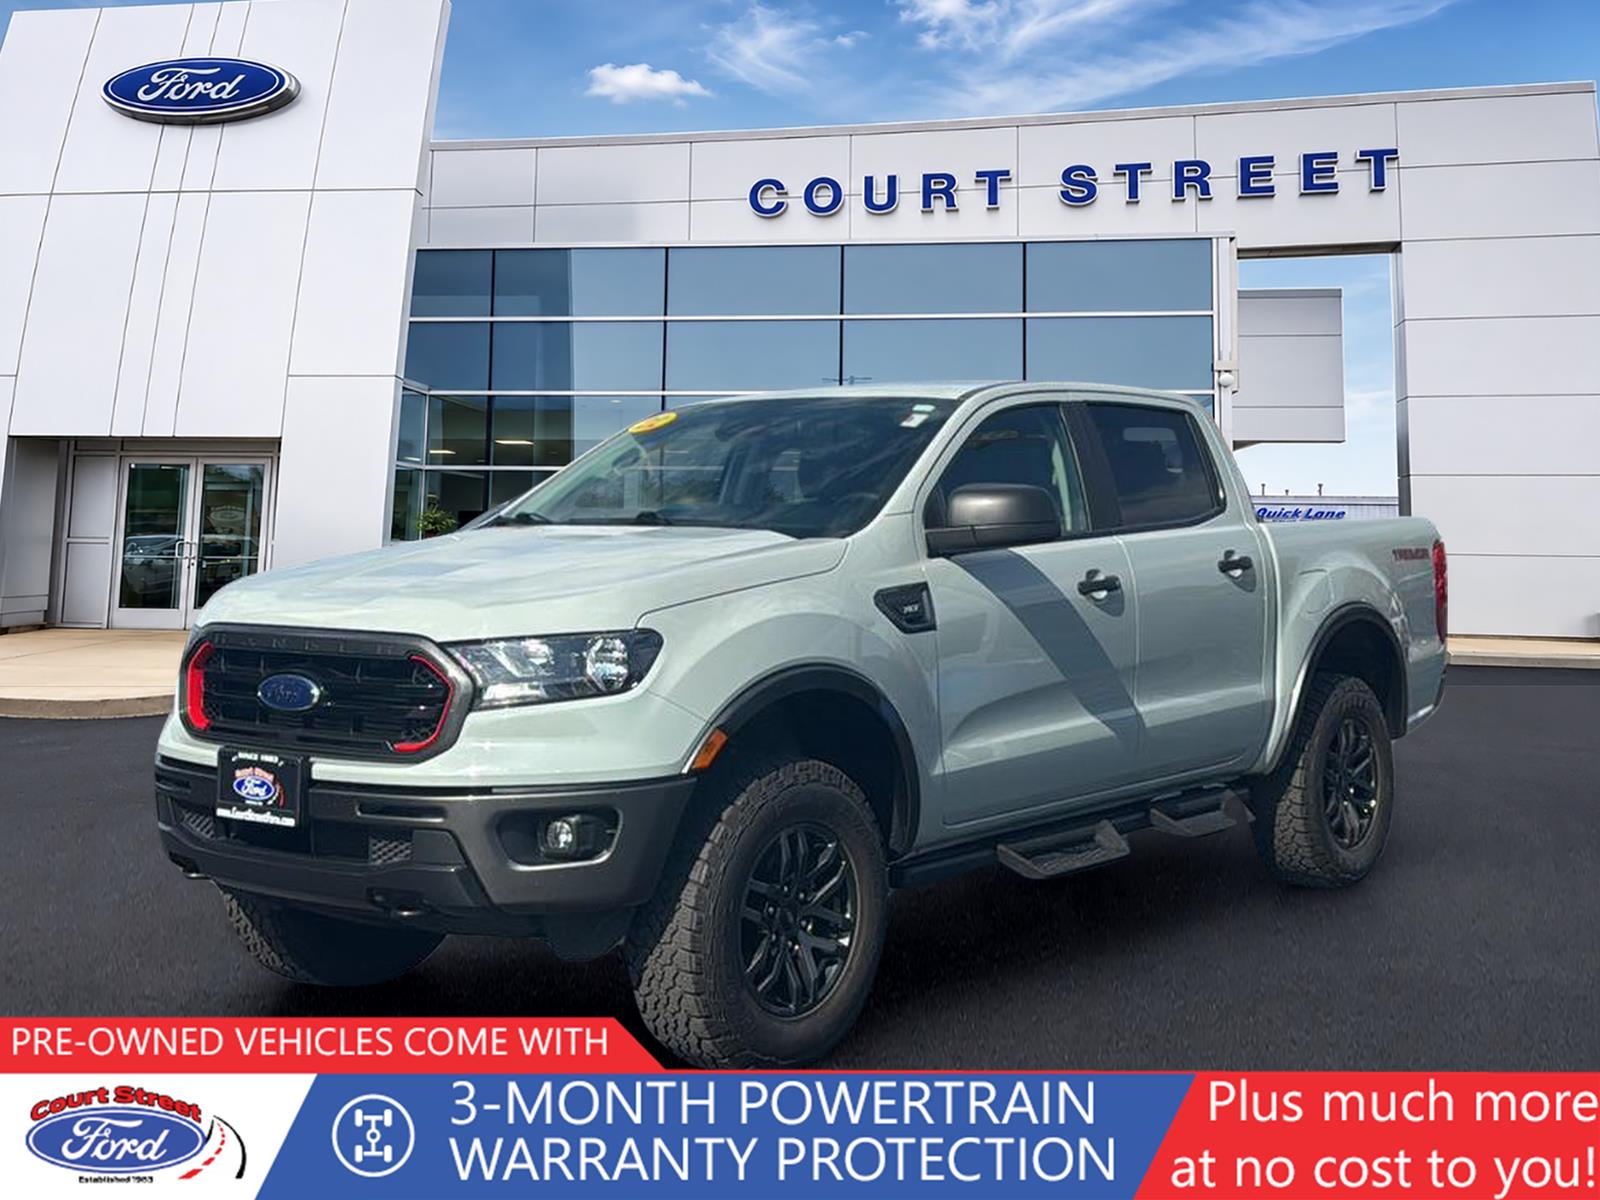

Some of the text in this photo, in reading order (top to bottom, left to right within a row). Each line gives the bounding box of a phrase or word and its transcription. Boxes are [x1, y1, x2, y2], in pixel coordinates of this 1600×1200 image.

[137, 67, 246, 102] Ford
[748, 148, 1399, 218] COURT STREET
[1256, 507, 1346, 520] Quick Lane
